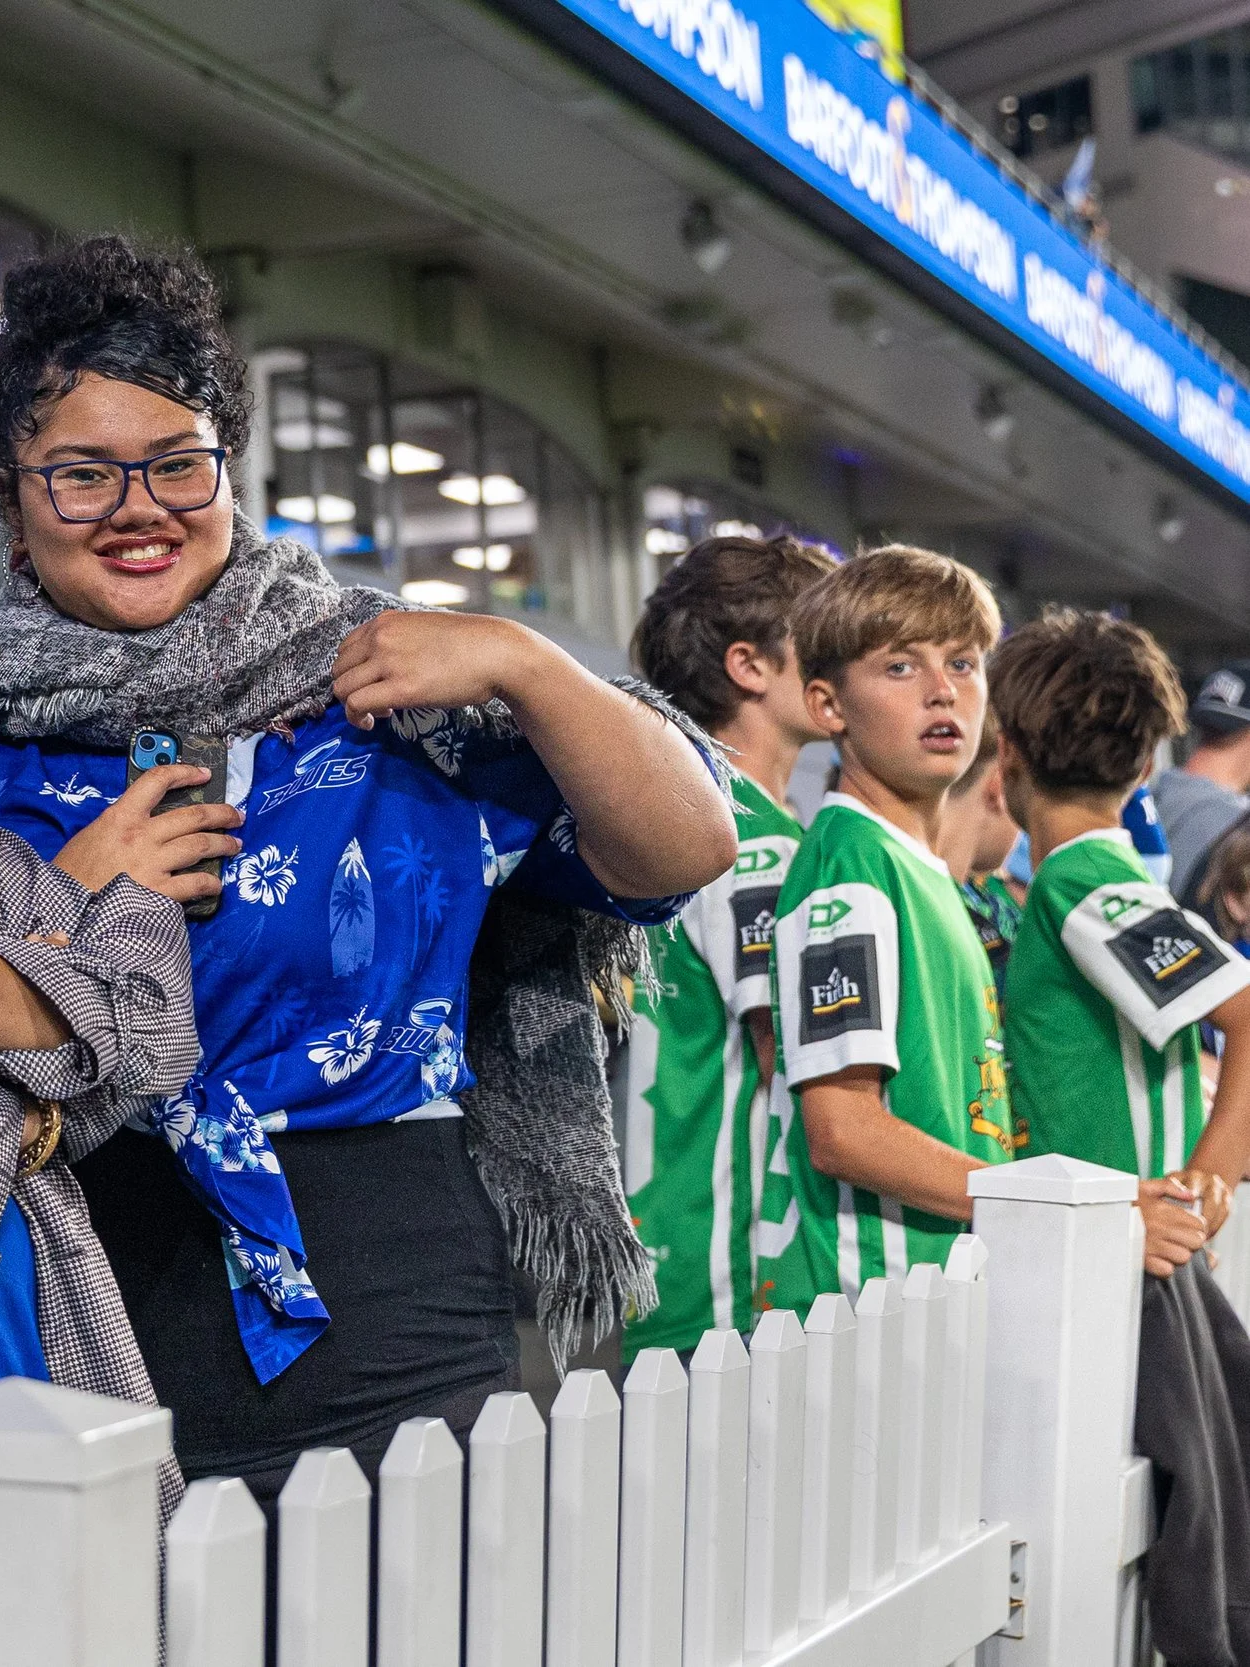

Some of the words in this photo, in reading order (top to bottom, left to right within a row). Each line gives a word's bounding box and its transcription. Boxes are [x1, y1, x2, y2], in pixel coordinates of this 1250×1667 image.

[257, 753, 372, 815] BLUES
[740, 924, 774, 945] Fir
[378, 1026, 434, 1057] BLU
